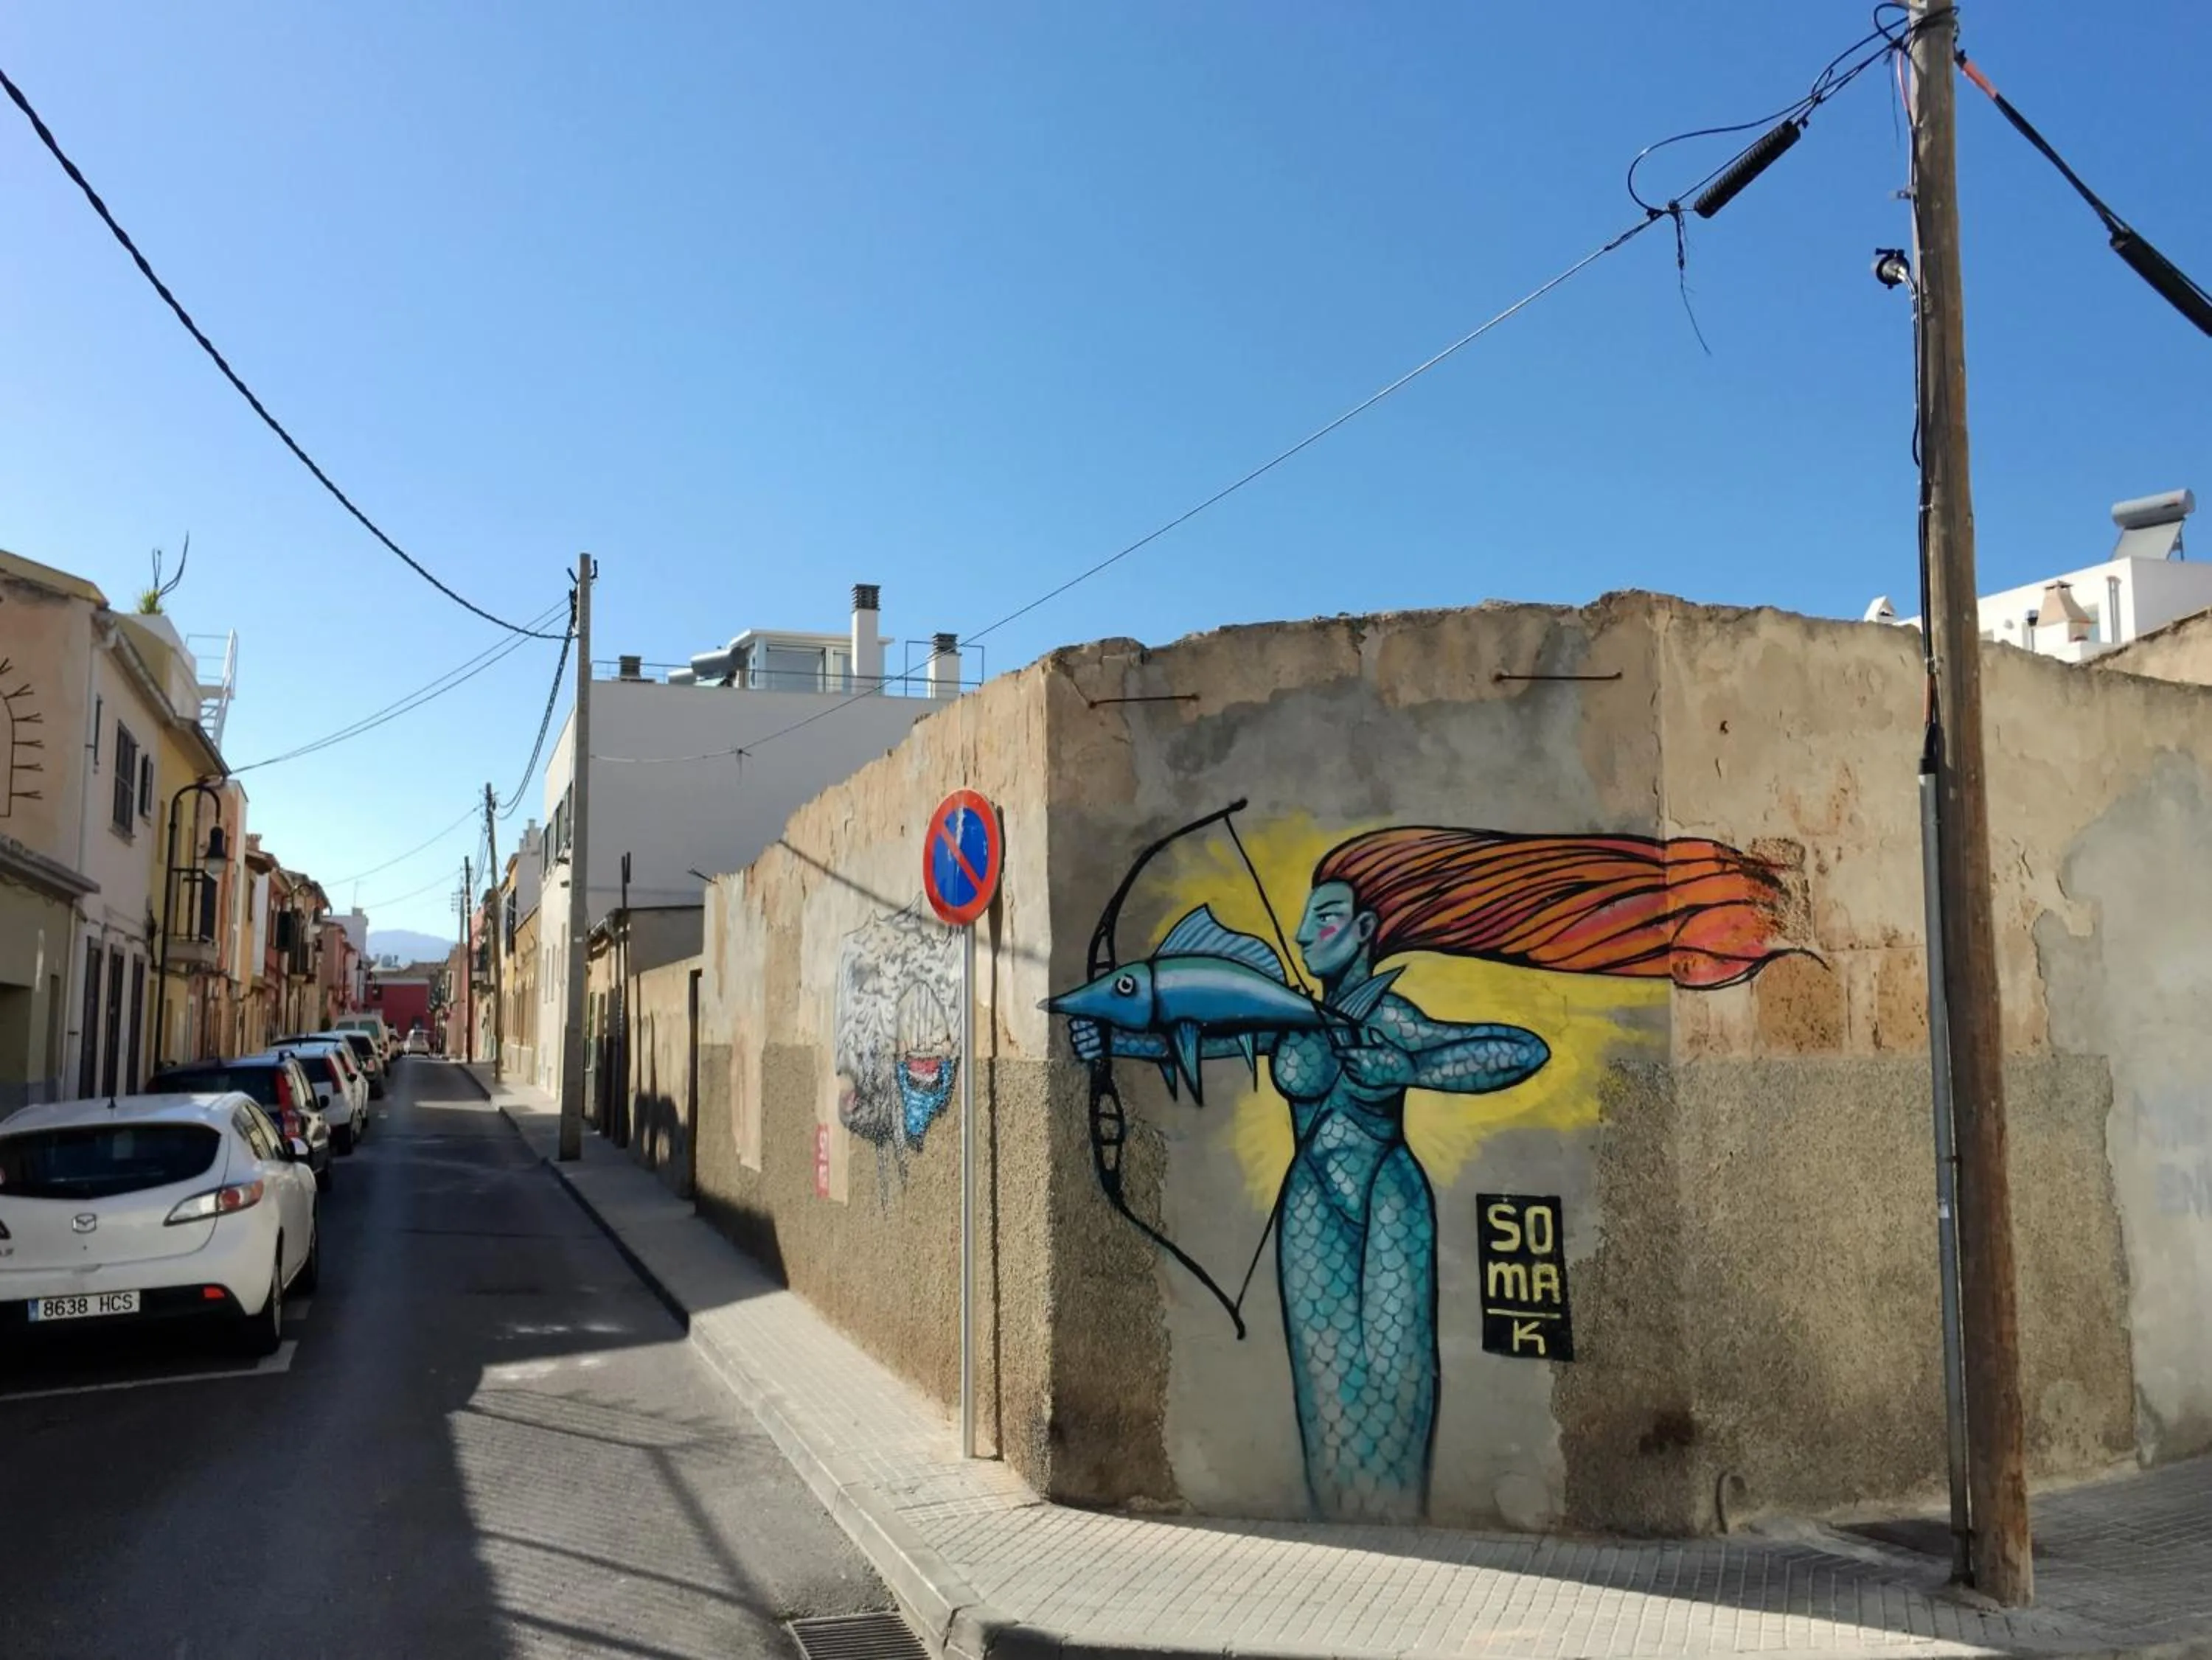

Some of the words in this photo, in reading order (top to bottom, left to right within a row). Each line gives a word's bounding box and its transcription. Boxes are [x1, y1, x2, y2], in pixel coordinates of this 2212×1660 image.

[1486, 1203, 1554, 1255] SO
[43, 1297, 88, 1318] 8638
[99, 1293, 133, 1313] HCS
[1512, 1319, 1546, 1356] K
